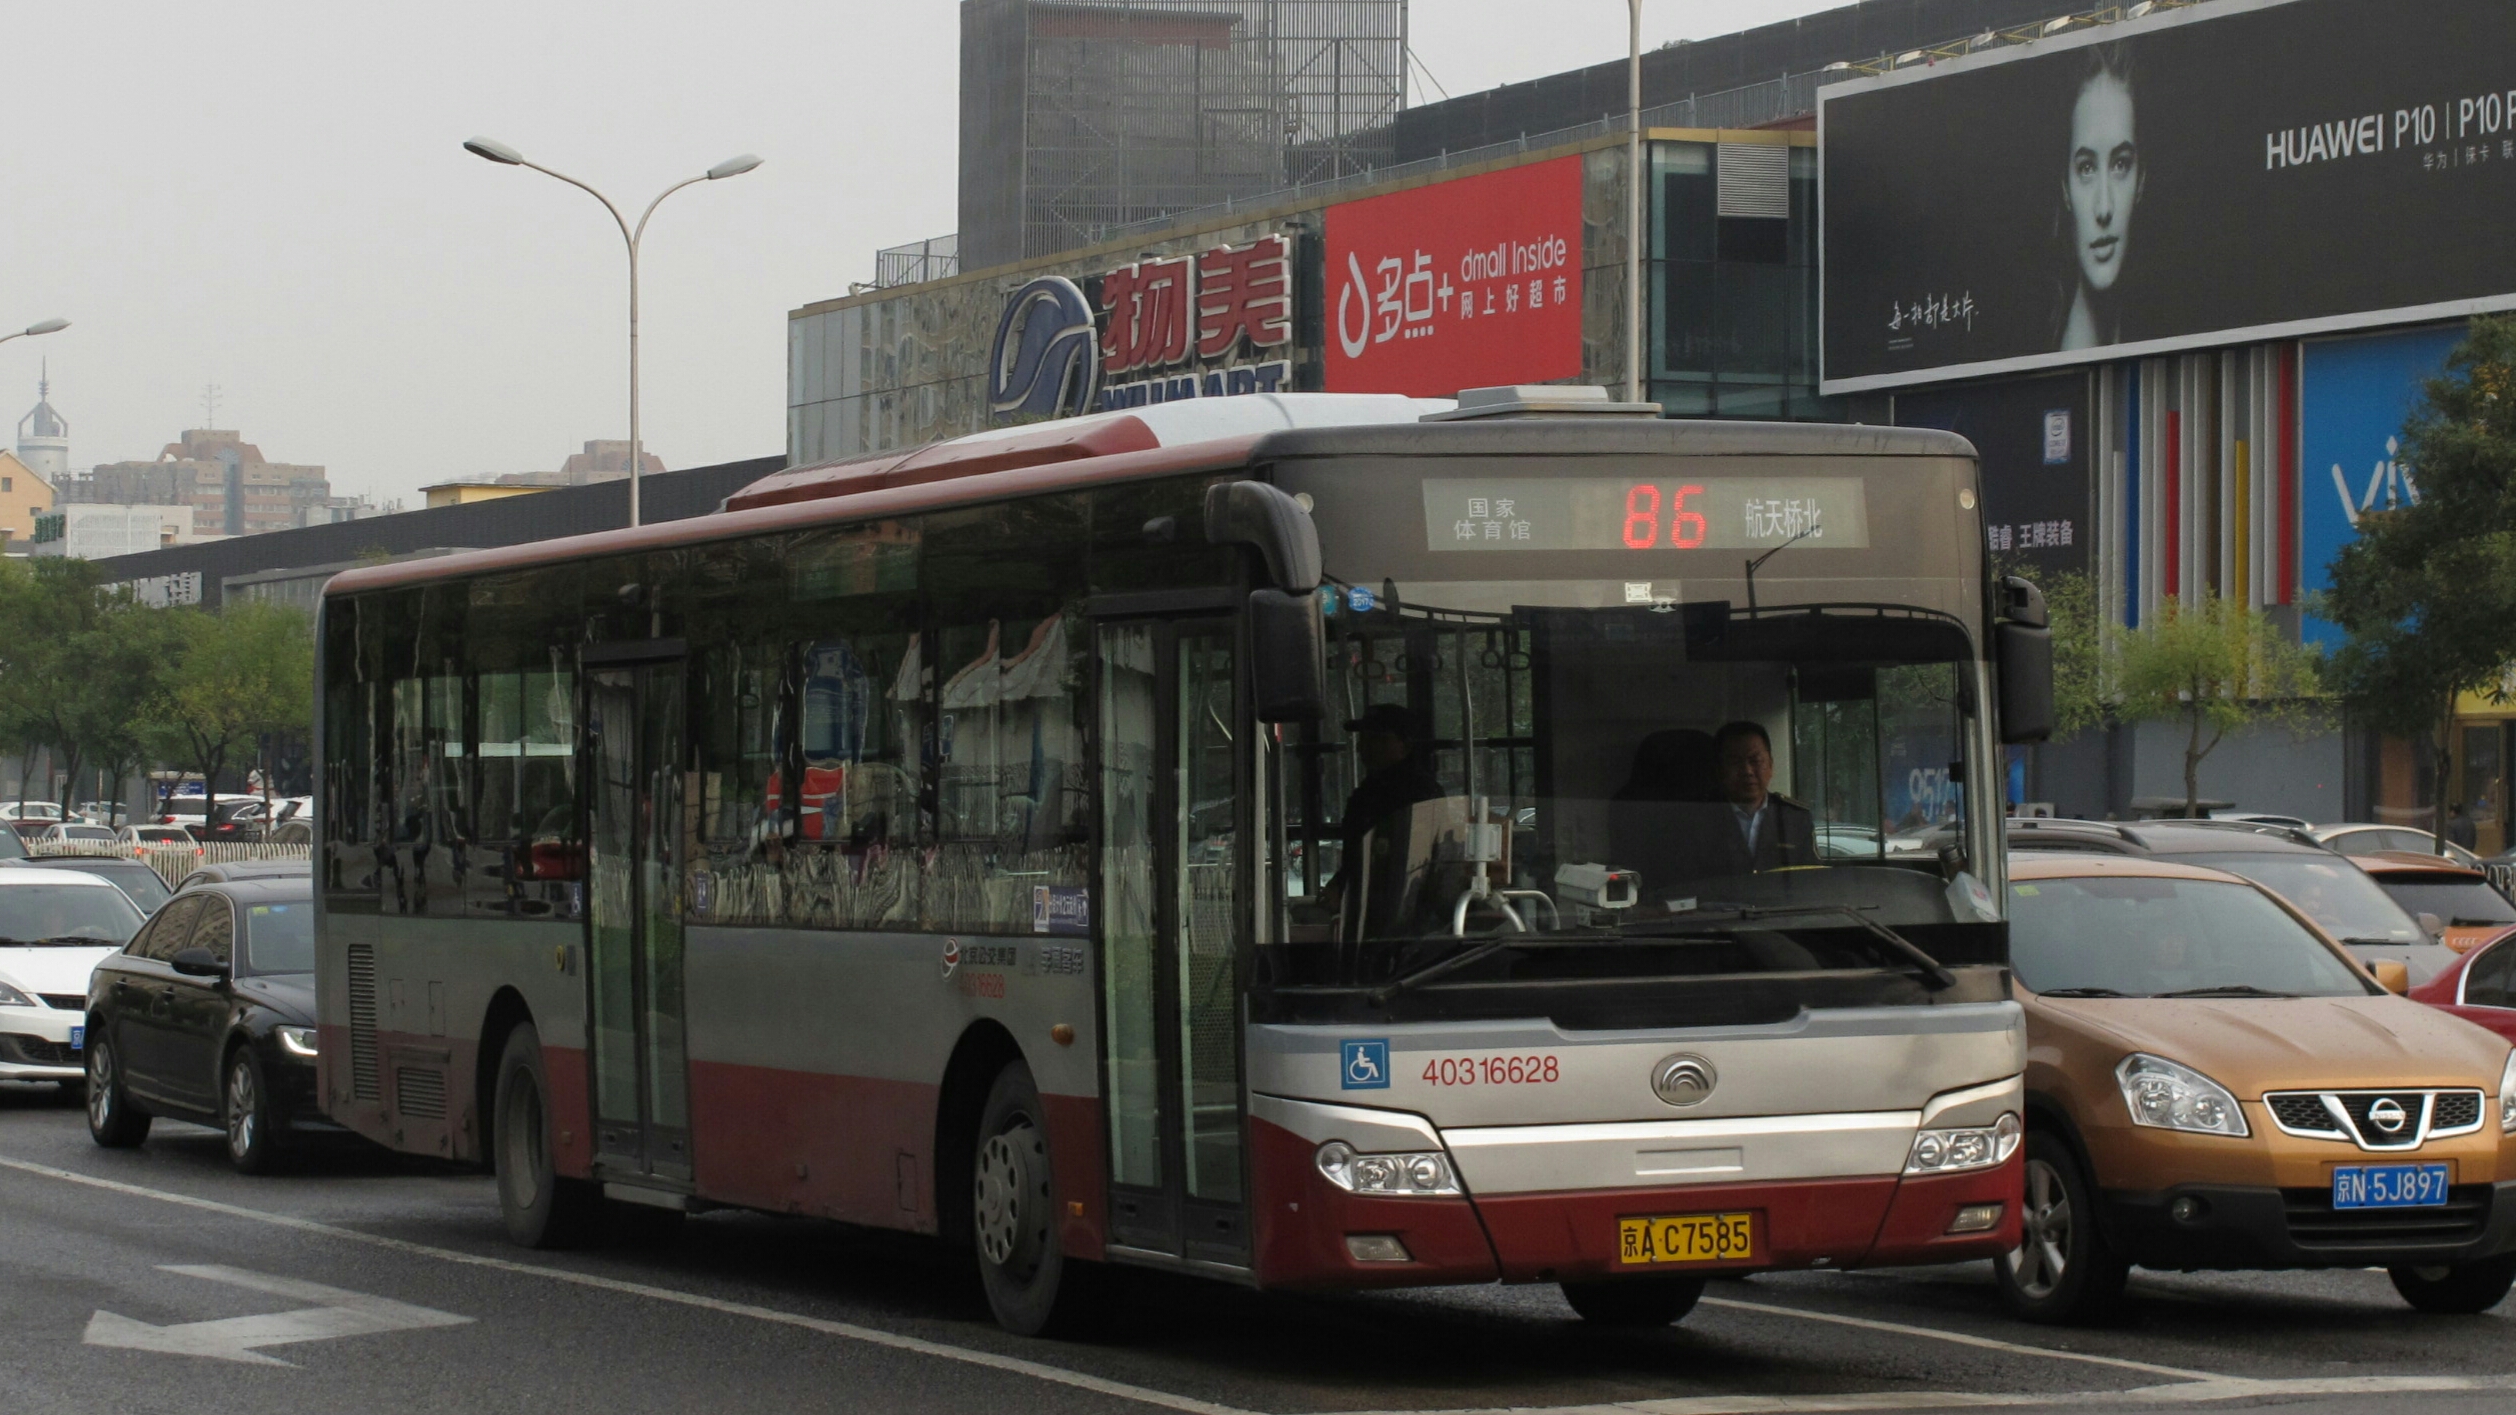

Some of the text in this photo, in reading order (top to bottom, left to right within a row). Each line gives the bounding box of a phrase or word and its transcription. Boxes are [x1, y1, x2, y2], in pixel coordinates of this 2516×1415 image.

[2266, 113, 2384, 170] HUAWEI
[2395, 103, 2436, 149] P10
[2459, 92, 2501, 138] P10
[2423, 151, 2448, 171] 华为
[1461, 233, 1567, 282] dmall Inside
[1100, 233, 1292, 375] 物美
[1461, 275, 1567, 319] 网上好超市
[1468, 498, 1515, 518] 国家
[1622, 484, 1707, 549] 86
[1745, 497, 1823, 539] 航天桥北
[1453, 519, 1531, 540] 体育馆
[2019, 519, 2073, 549] 王牌装备
[1421, 1055, 1560, 1087] 40316628
